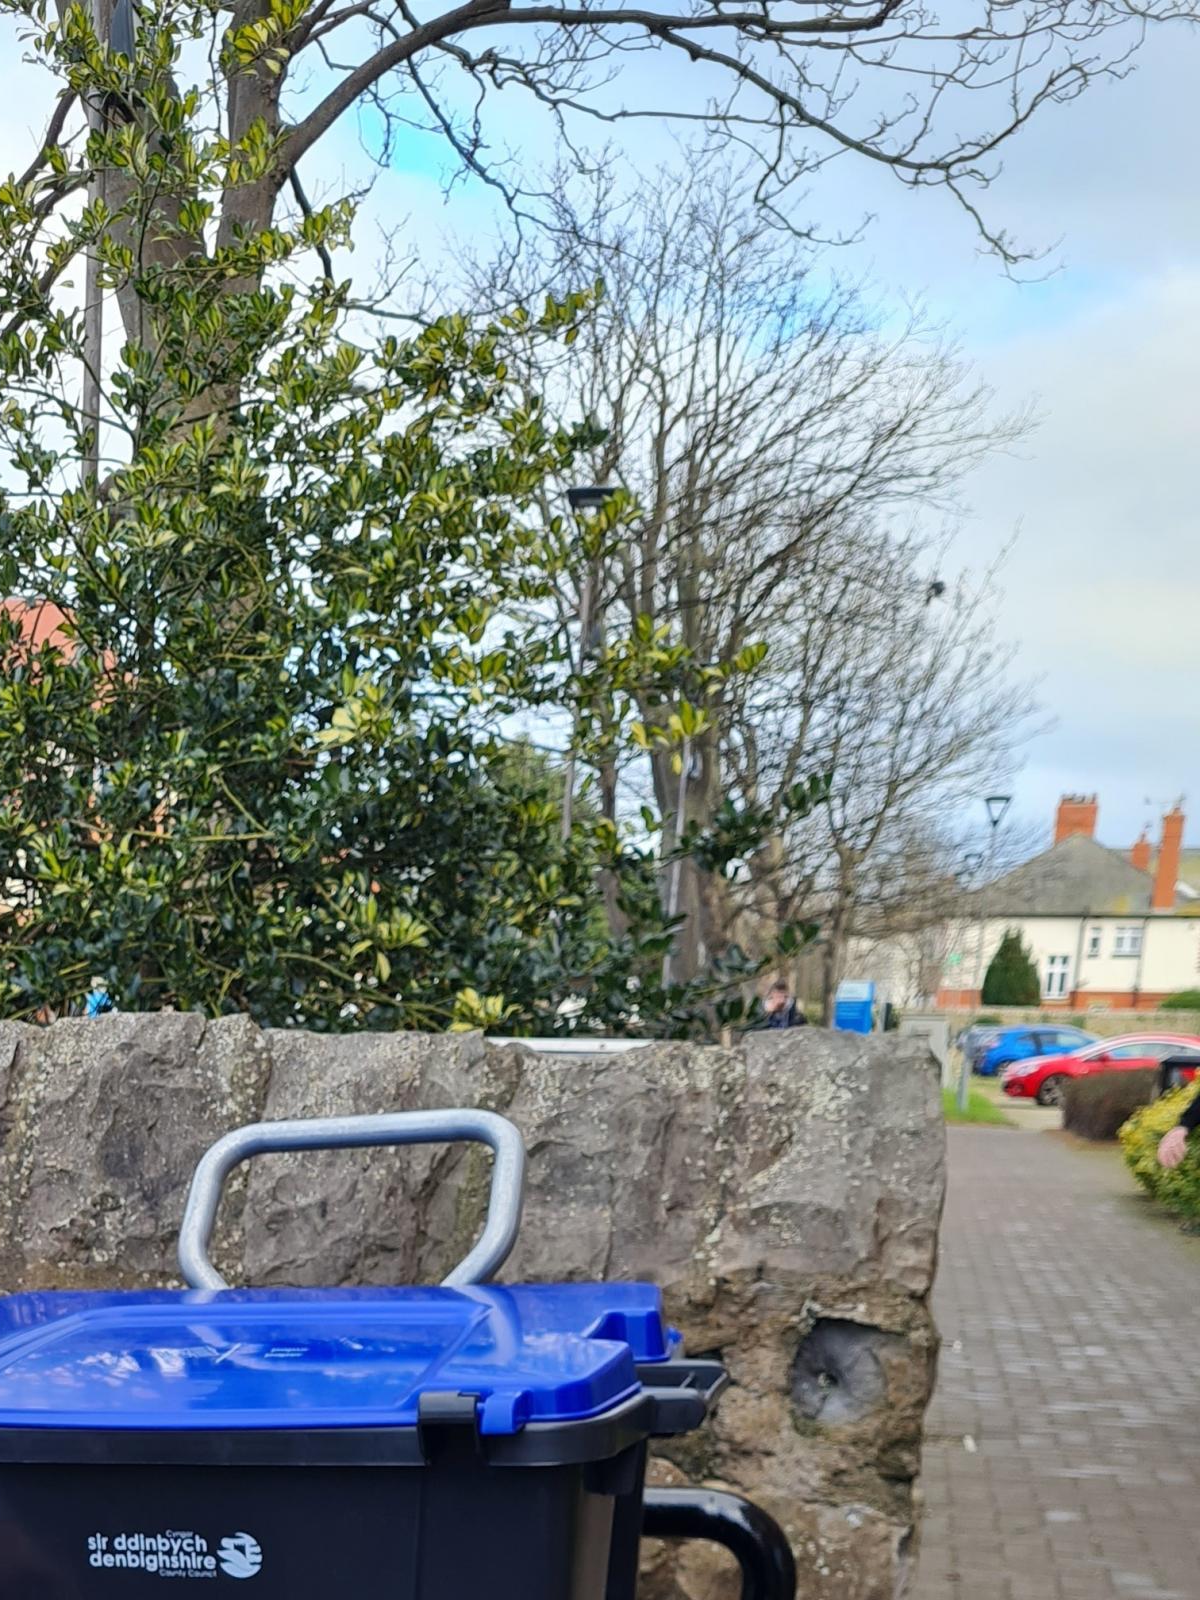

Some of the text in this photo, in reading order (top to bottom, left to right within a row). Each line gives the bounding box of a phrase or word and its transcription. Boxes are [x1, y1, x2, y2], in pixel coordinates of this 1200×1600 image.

[165, 1529, 194, 1539] Cyngor
[88, 1533, 208, 1556] sir ddinbych
[89, 1550, 217, 1572] denbighshire
[159, 1569, 217, 1579] County Council
